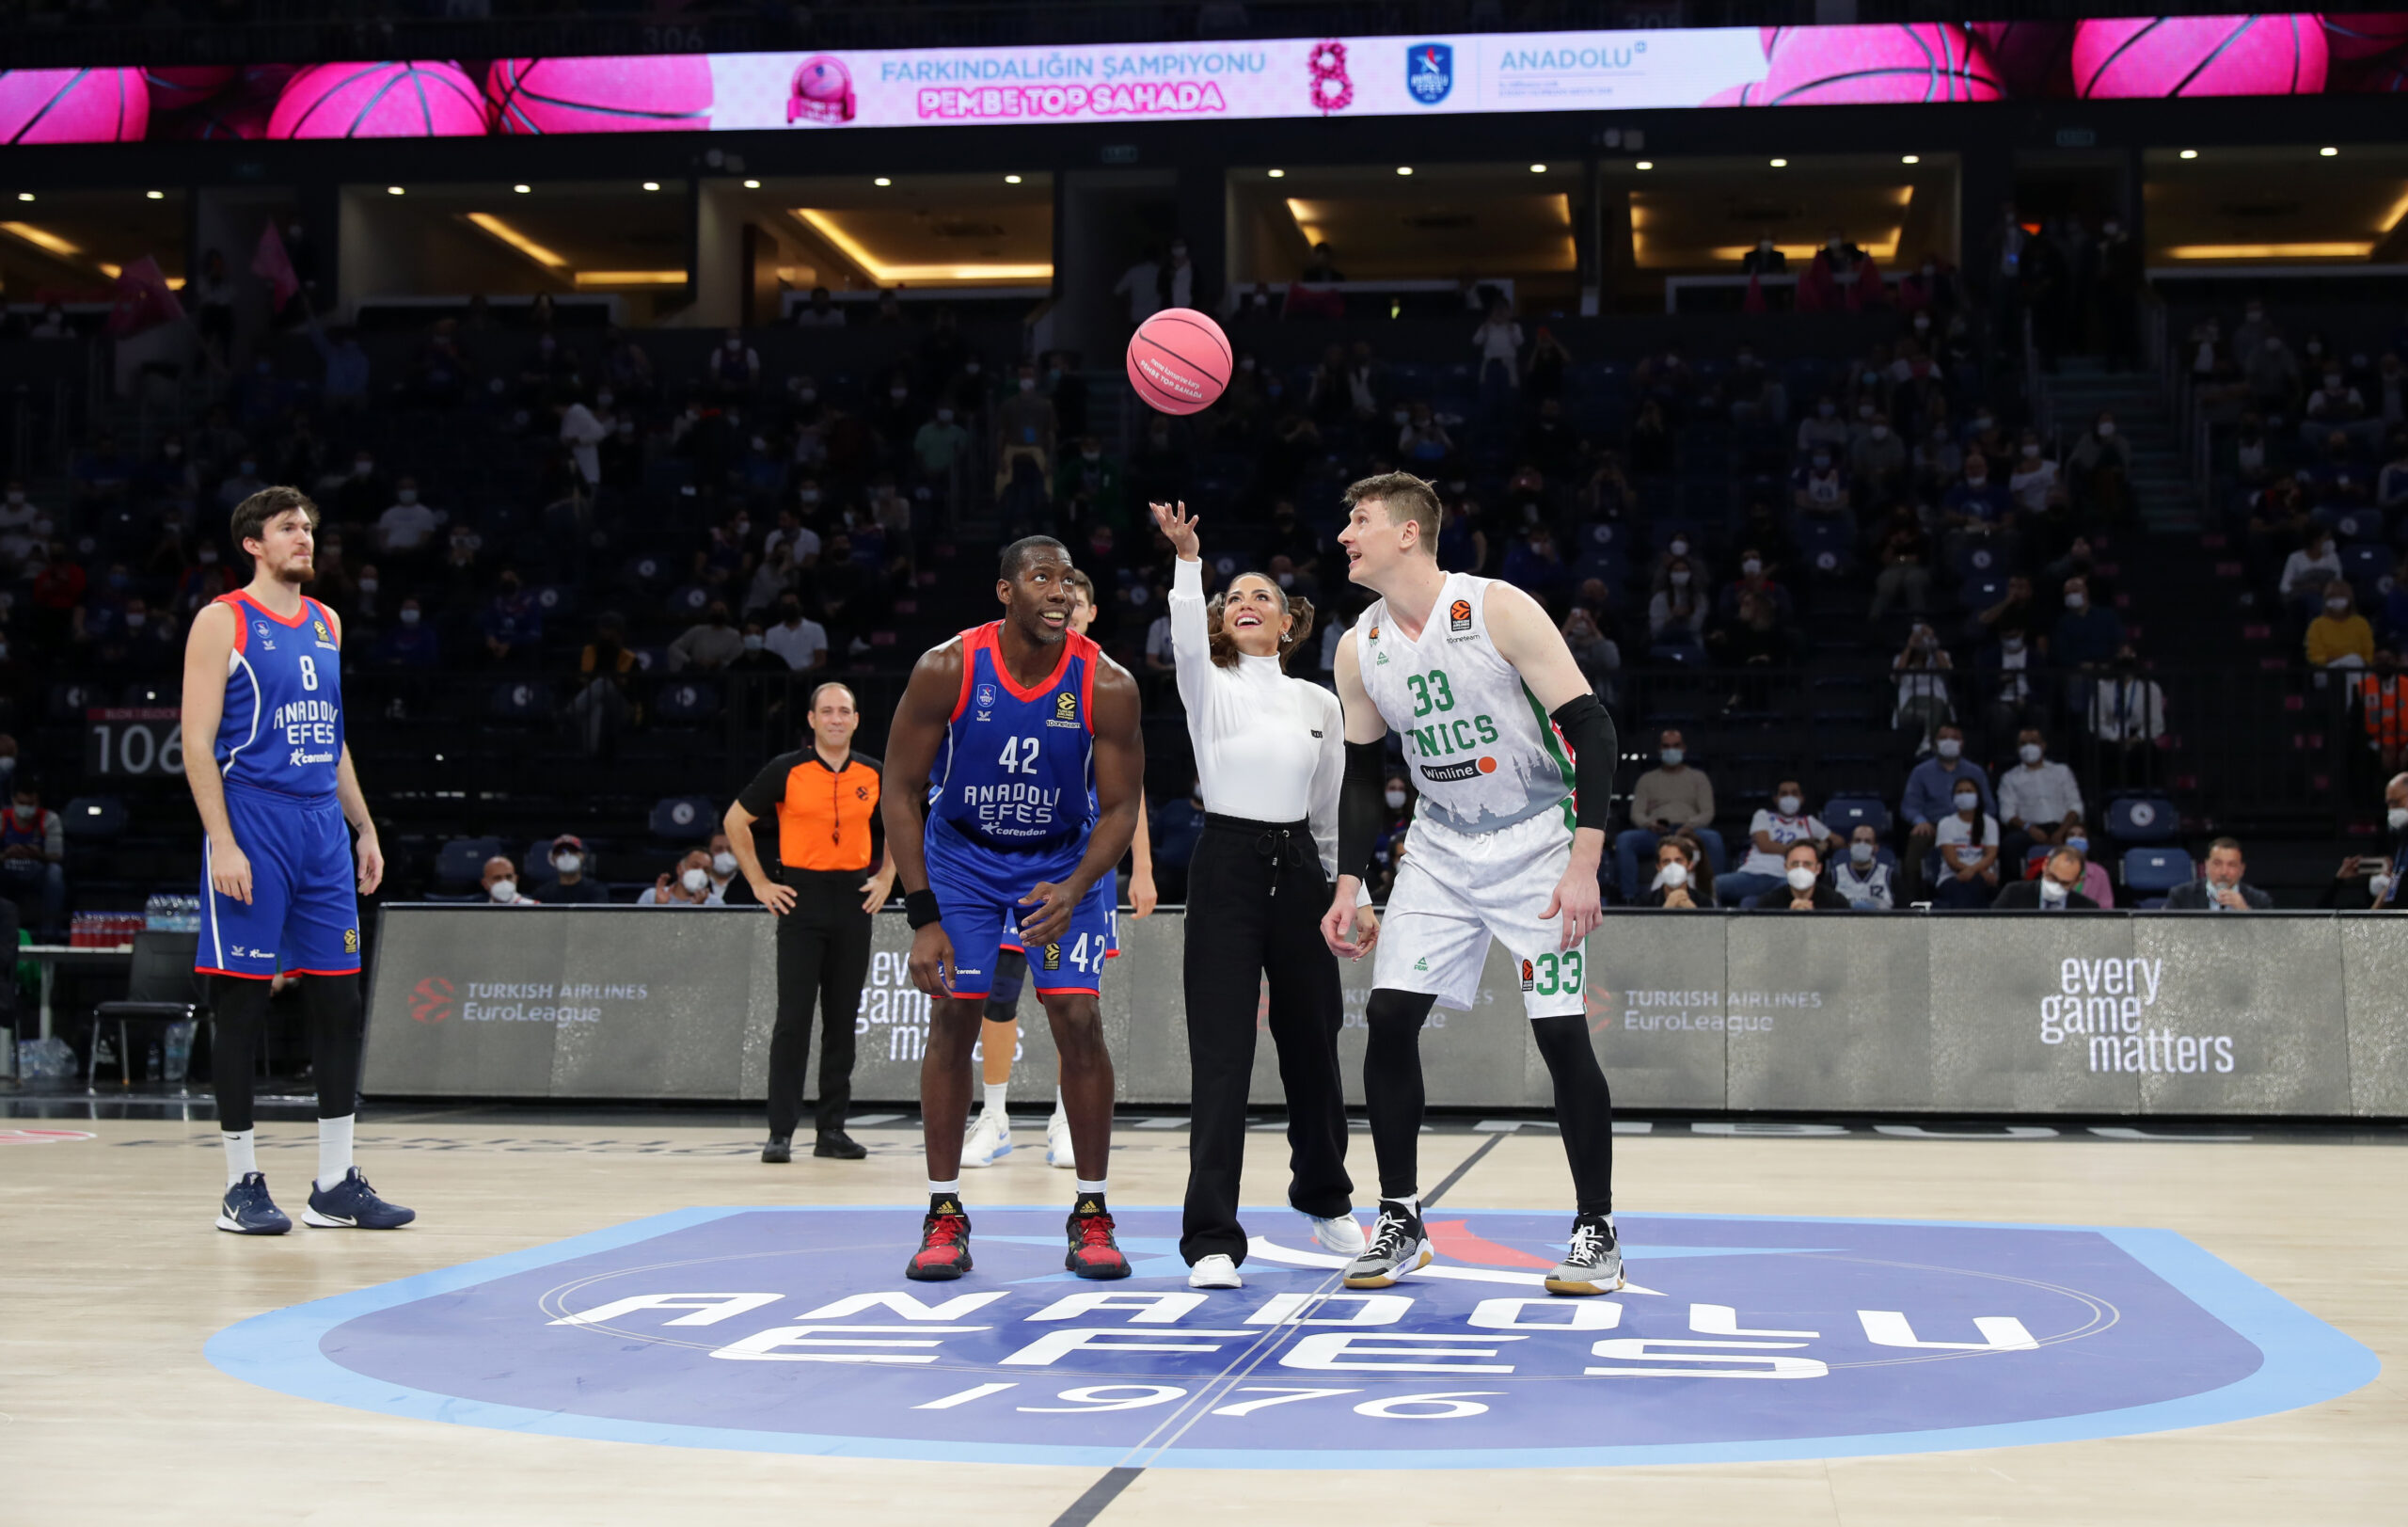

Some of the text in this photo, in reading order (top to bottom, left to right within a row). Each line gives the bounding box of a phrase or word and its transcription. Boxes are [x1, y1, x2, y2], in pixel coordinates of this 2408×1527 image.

[881, 52, 1265, 82] FARKINDALIĞIN ŞAMPİYONU
[1499, 48, 1632, 71] ANADOLU
[918, 81, 1225, 118] PEMBE TOP SAHADA
[299, 655, 318, 691] 8
[1407, 670, 1454, 718] 33
[92, 724, 185, 774] 106
[287, 723, 335, 744] EFES
[1405, 714, 1498, 757] NICS
[999, 736, 1039, 775] 42
[1422, 766, 1474, 780] Winline
[979, 803, 1052, 823] EFES
[995, 828, 1046, 836] corendon
[1069, 930, 1106, 975] 42
[467, 982, 648, 1000] TURKISH AIRLINES
[1535, 950, 1582, 995] 33
[2060, 957, 2162, 1005] every
[463, 1002, 602, 1028] EuroLeague
[1624, 990, 1823, 1009] TURKISH AIRLINES
[1624, 1010, 1774, 1036] EuroLeague
[2039, 994, 2142, 1044] game
[2088, 1028, 2235, 1074] matters
[547, 1290, 2040, 1351] ANADOLU
[708, 1326, 1830, 1380] EFES
[911, 1382, 1509, 1419] 1976
